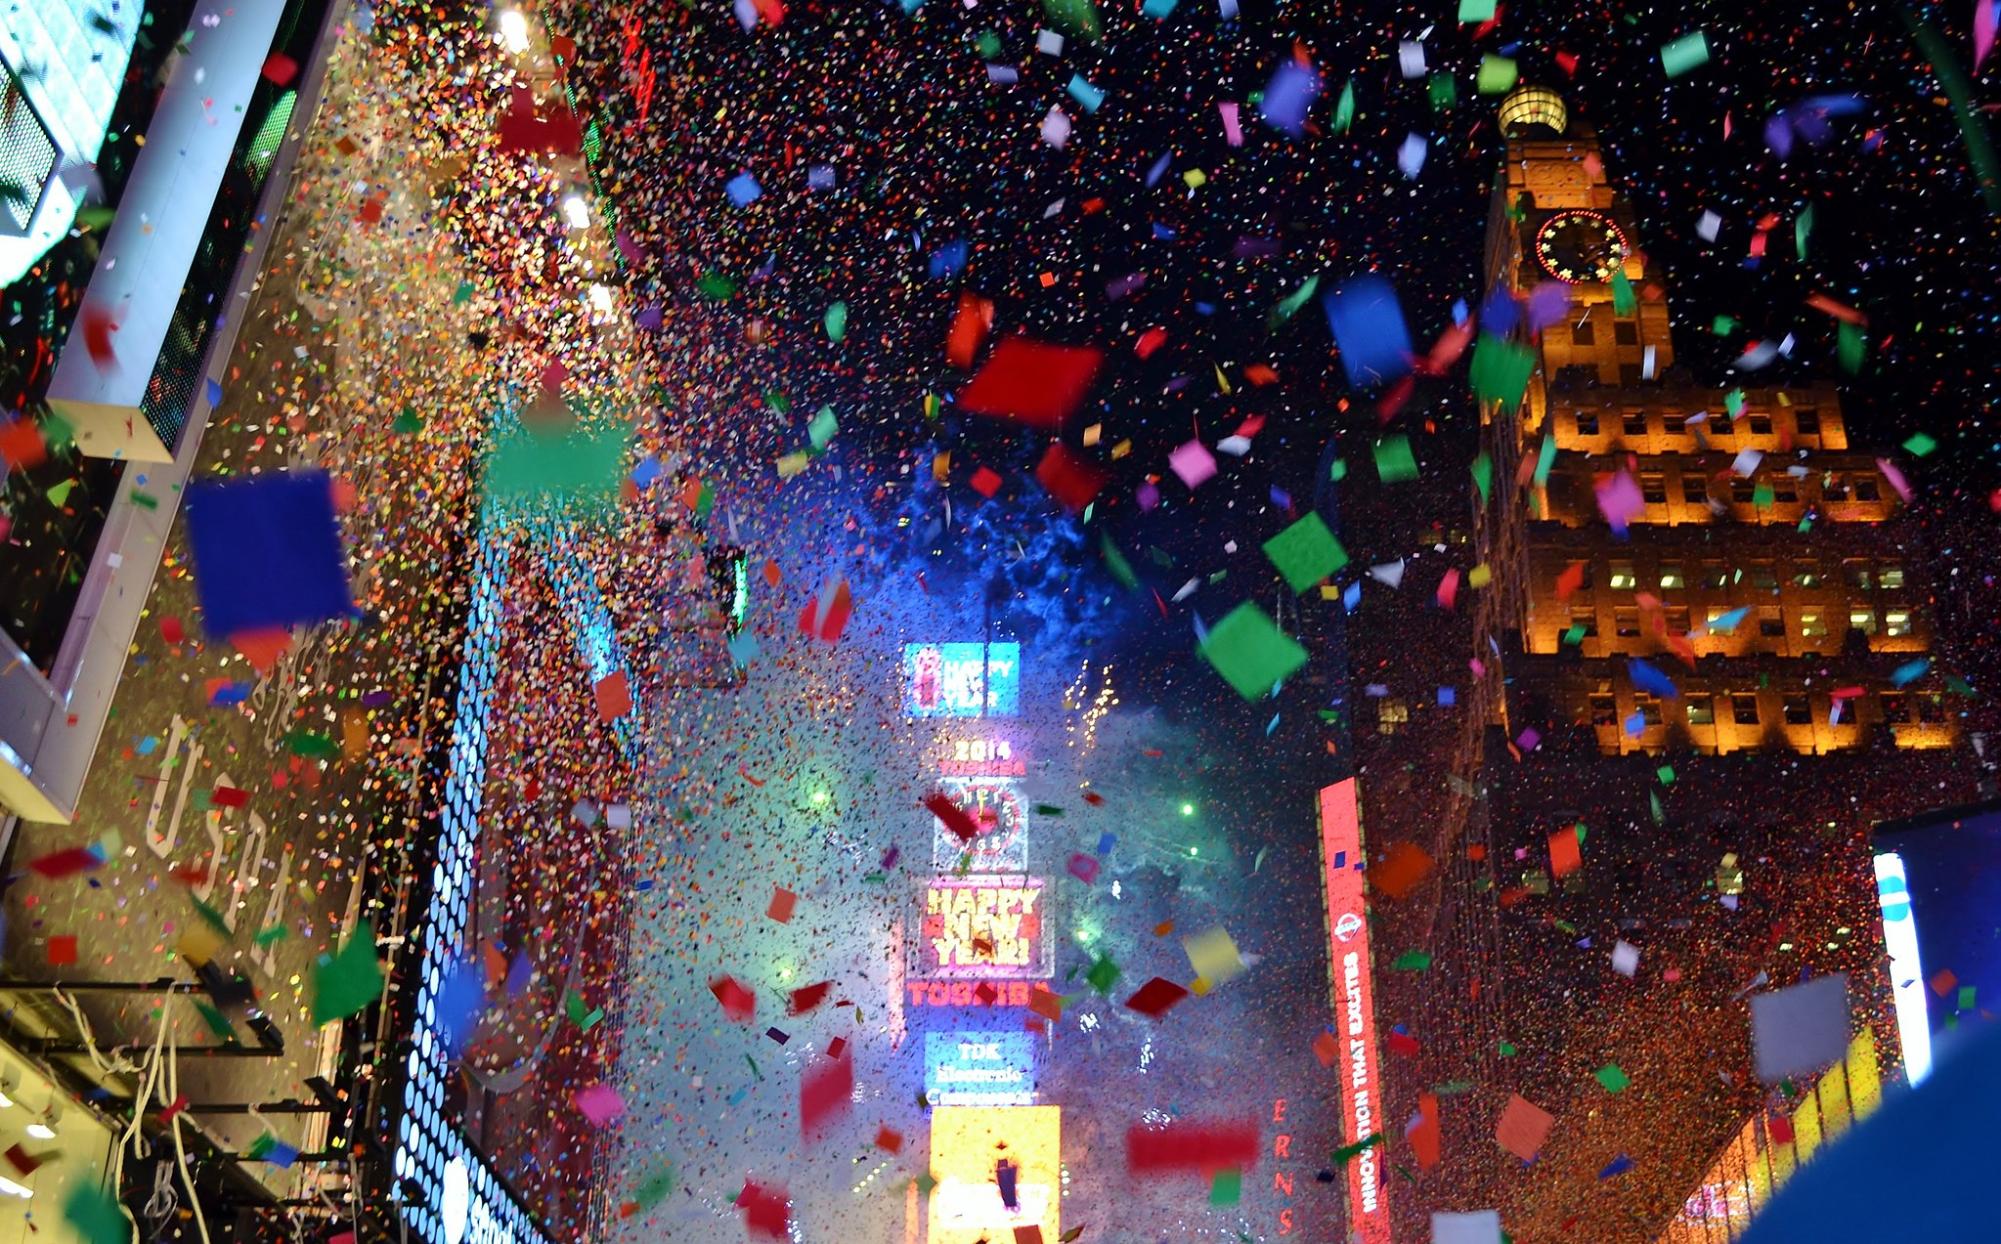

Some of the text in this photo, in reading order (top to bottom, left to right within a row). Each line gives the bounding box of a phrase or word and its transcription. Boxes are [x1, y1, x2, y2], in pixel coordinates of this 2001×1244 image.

[954, 740, 1011, 760] 2014
[928, 888, 1041, 914] HAPPY
[944, 913, 1022, 939] NEW
[932, 937, 1030, 965] YEAR!
[1343, 951, 1364, 1036] EXCITES
[957, 1043, 1001, 1060] TDK
[1350, 1039, 1367, 1089] THAT
